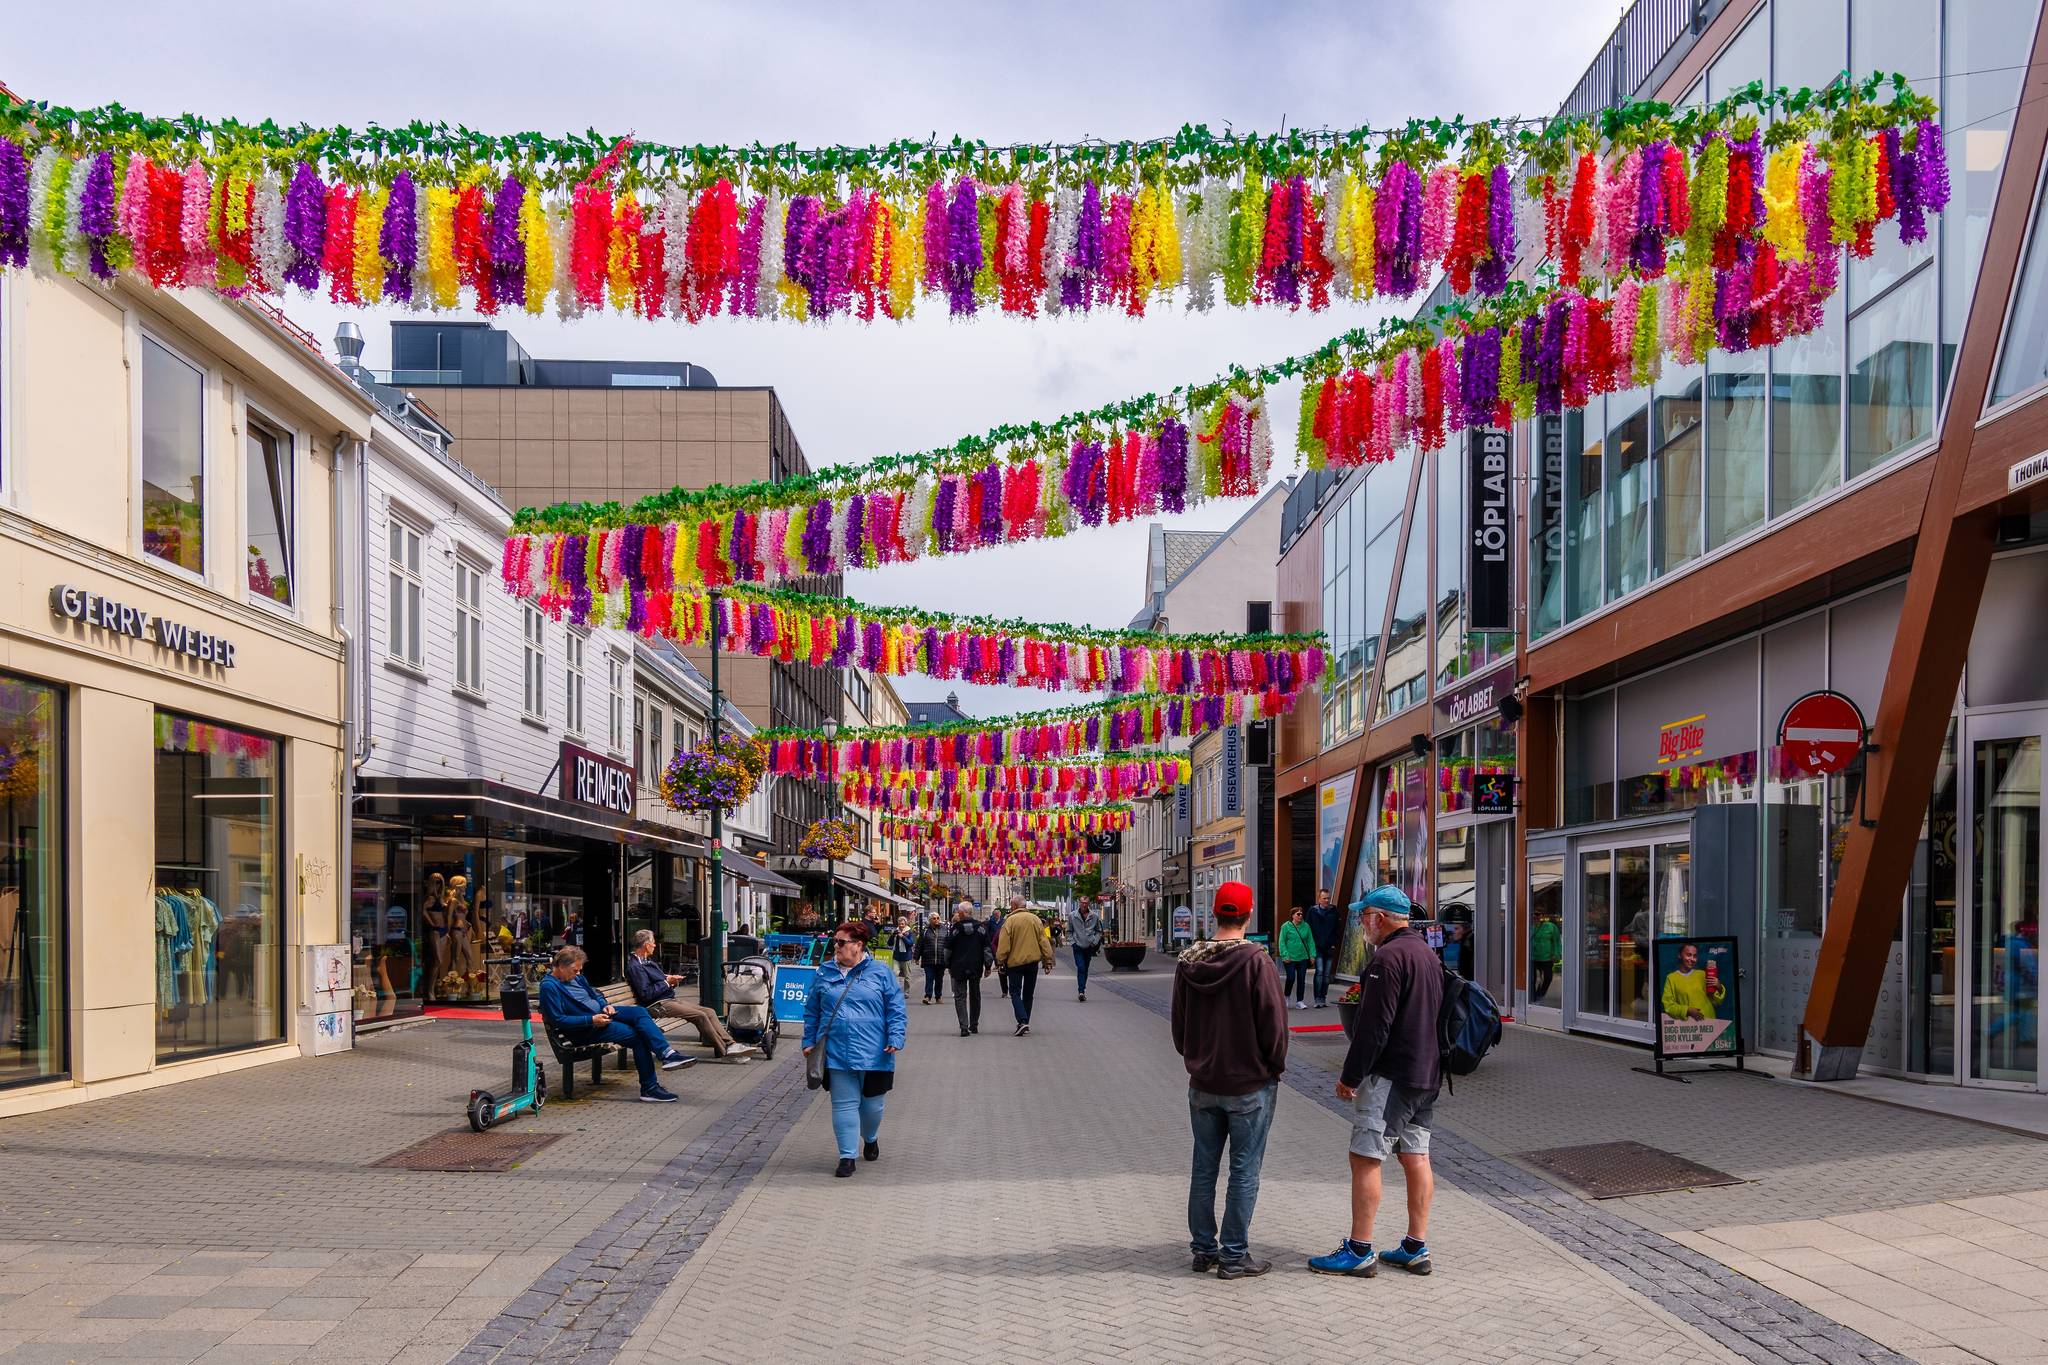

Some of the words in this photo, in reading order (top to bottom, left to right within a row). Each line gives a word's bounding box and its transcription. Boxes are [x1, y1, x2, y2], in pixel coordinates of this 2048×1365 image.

[57, 584, 149, 639] GERRY
[157, 617, 237, 667] WEBER
[1449, 685, 1494, 723] LÖPLABBET
[577, 755, 632, 814] REIMERS
[1664, 1026, 1679, 1034] DIGG
[1679, 1025, 1698, 1033] WRAP
[1699, 1024, 1714, 1033] MED
[1677, 1033, 1703, 1041] KYLLING
